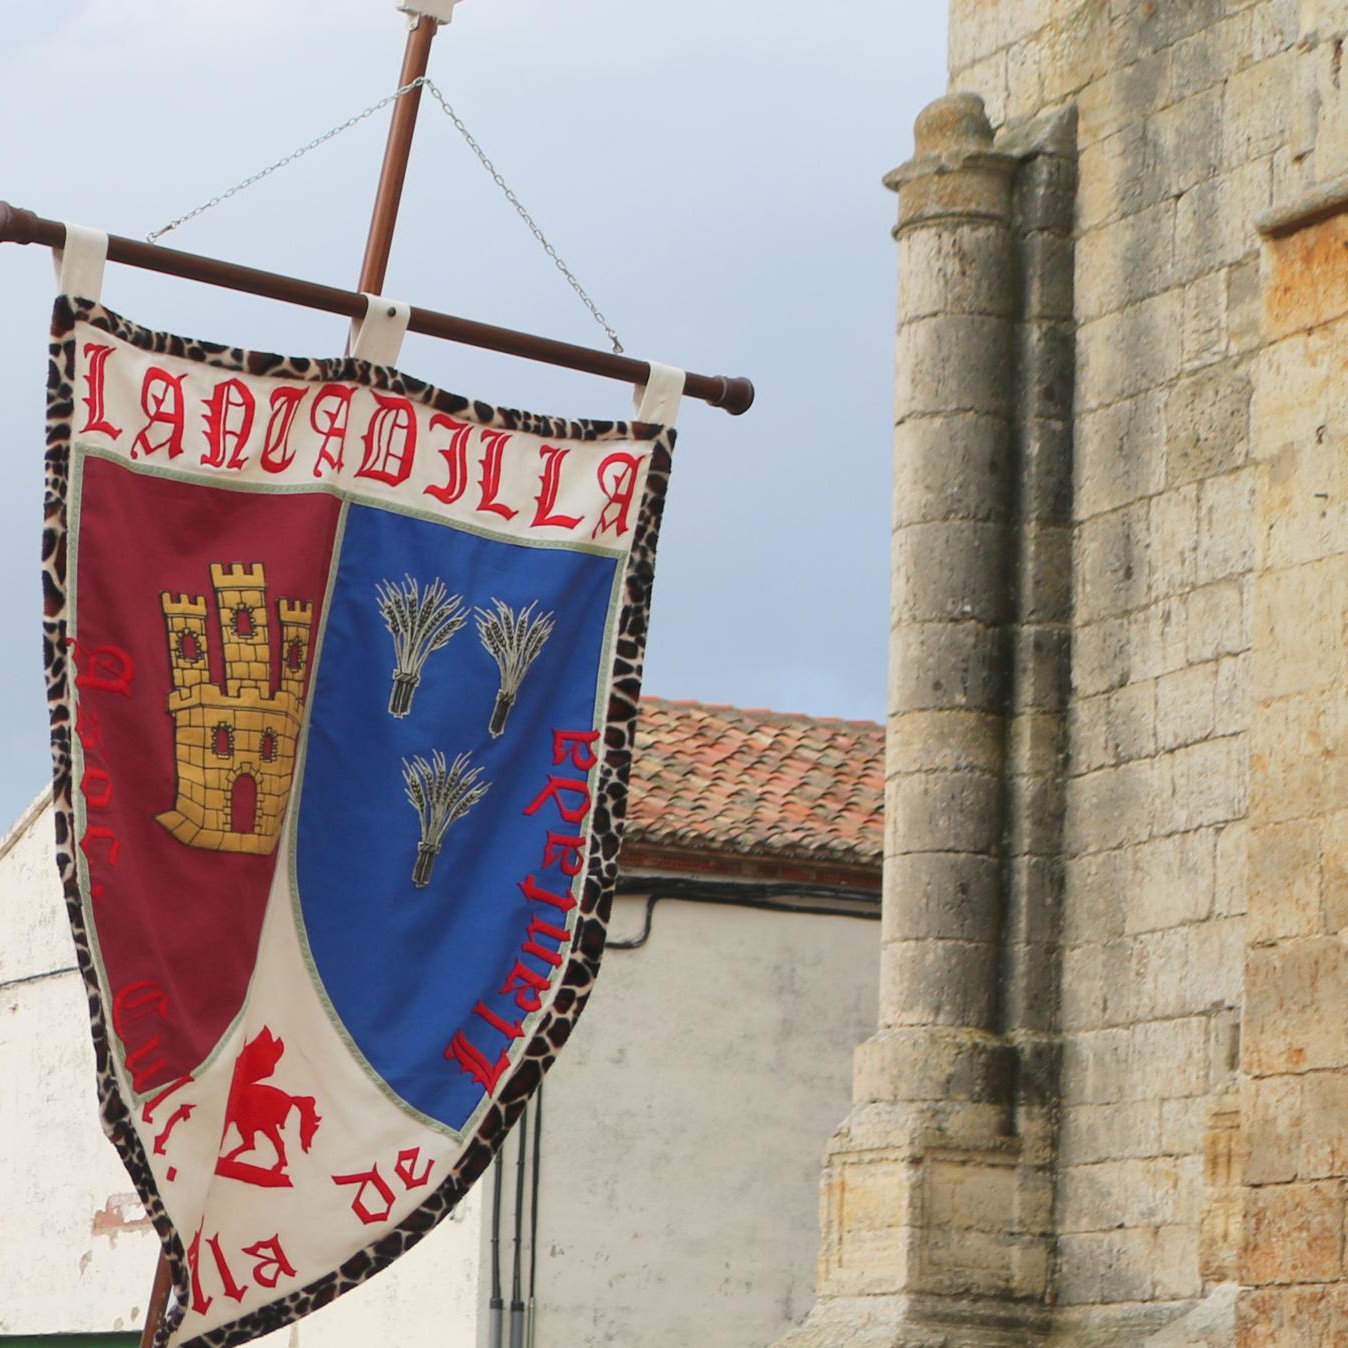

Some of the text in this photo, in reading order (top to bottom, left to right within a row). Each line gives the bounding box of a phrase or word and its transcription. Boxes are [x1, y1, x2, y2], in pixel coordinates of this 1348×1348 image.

[79, 342, 643, 541] LANTADILLA
[331, 1147, 436, 1226] de
[444, 728, 601, 1098] Llantada
